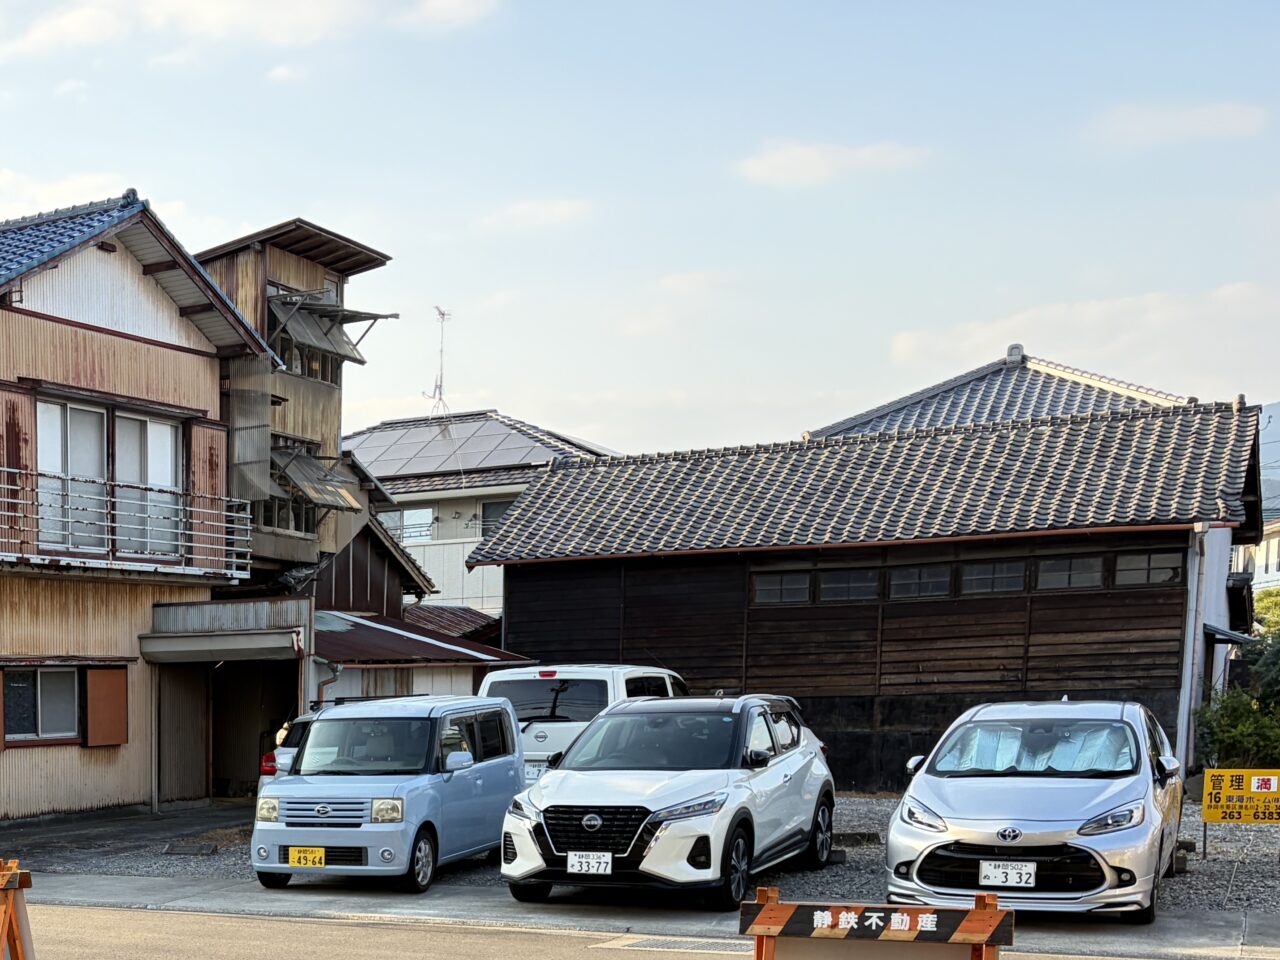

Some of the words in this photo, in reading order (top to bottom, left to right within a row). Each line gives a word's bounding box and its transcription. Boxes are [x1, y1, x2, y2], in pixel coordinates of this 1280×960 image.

[1210, 774, 1245, 791] 管理
[1256, 777, 1273, 791] 満
[1207, 791, 1222, 804] 16
[577, 860, 609, 873] 33-77
[813, 910, 938, 932] 静鉄不動産
